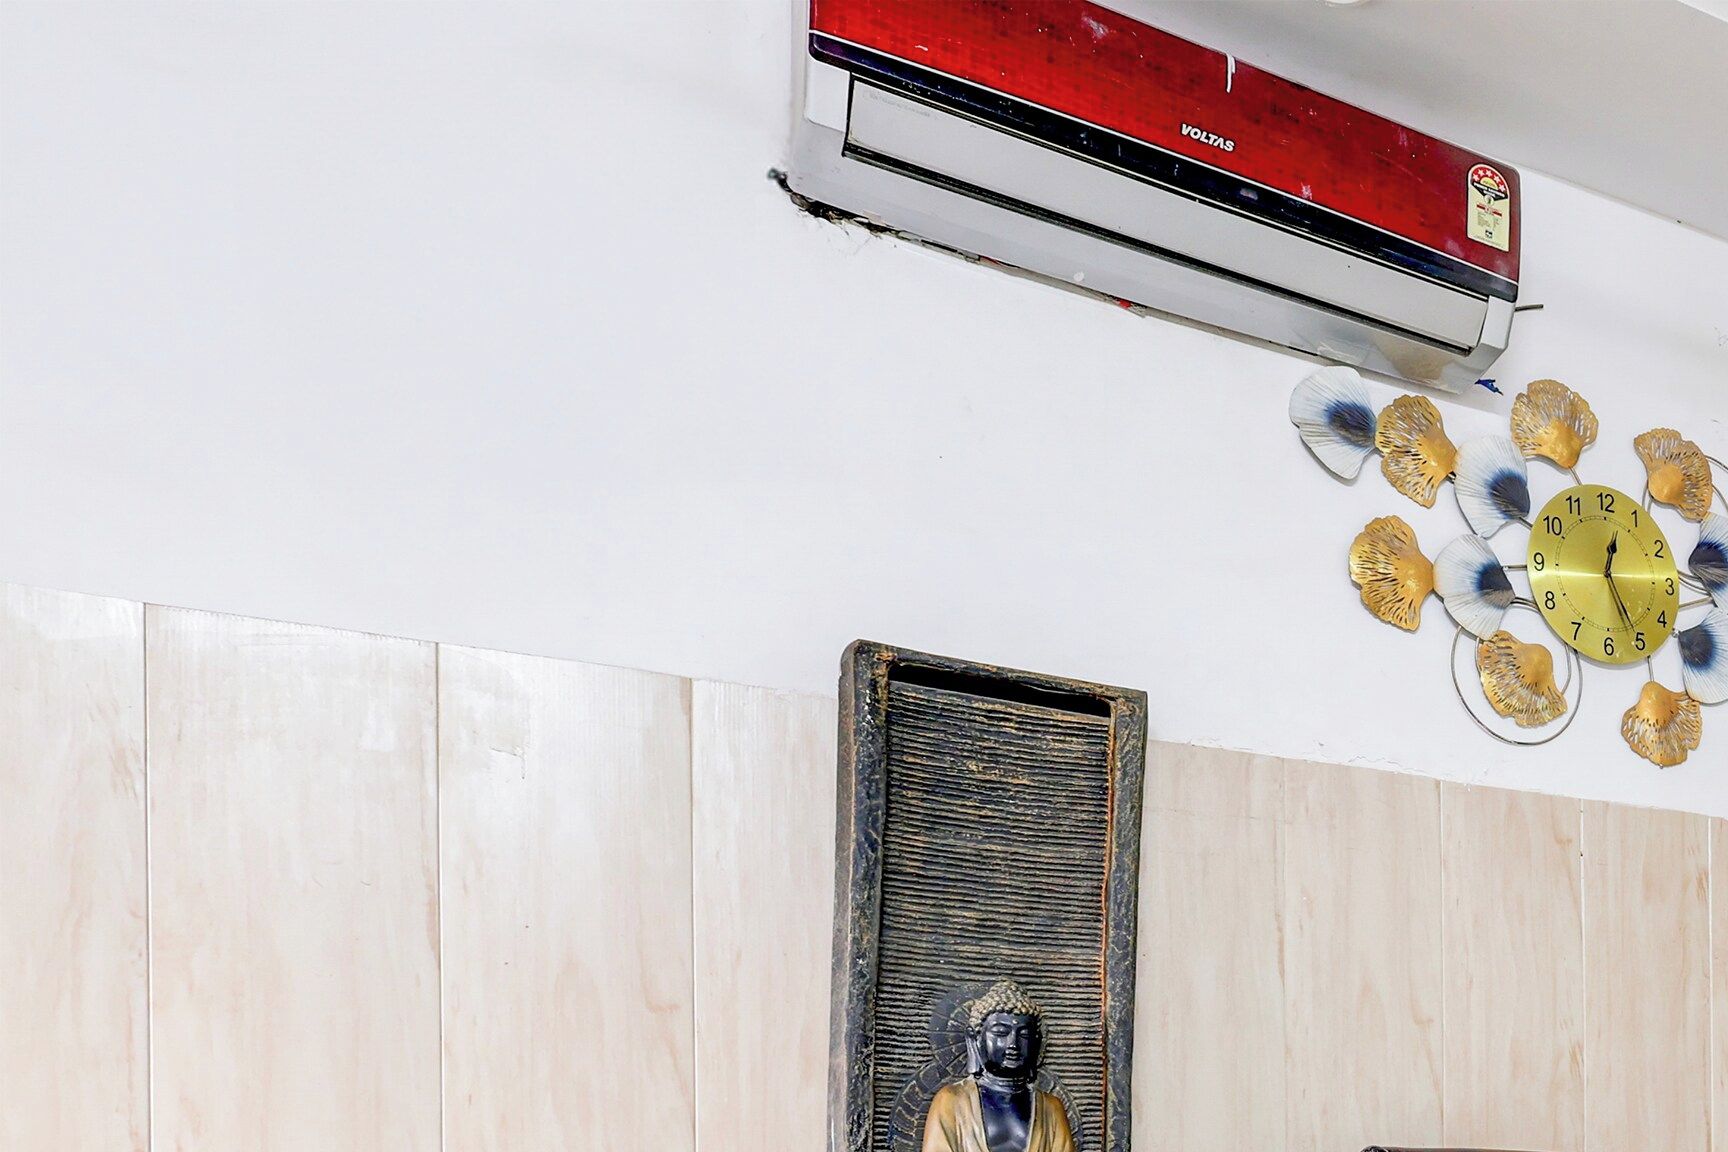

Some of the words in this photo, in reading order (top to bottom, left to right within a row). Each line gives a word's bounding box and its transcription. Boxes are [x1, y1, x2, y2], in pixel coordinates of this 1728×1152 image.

[1181, 123, 1235, 152] VOLTAS
[1565, 495, 1581, 516] 11
[1596, 492, 1615, 513] 12
[1543, 515, 1562, 536] 10
[1630, 510, 1639, 528] 1
[1654, 539, 1664, 559] 2
[1533, 552, 1545, 572] 9
[1664, 577, 1675, 596] 3
[1544, 591, 1556, 610] 8
[1657, 610, 1667, 628] 4
[1571, 621, 1582, 641] 7
[1604, 637, 1614, 656] 6
[1635, 632, 1646, 651] 5
